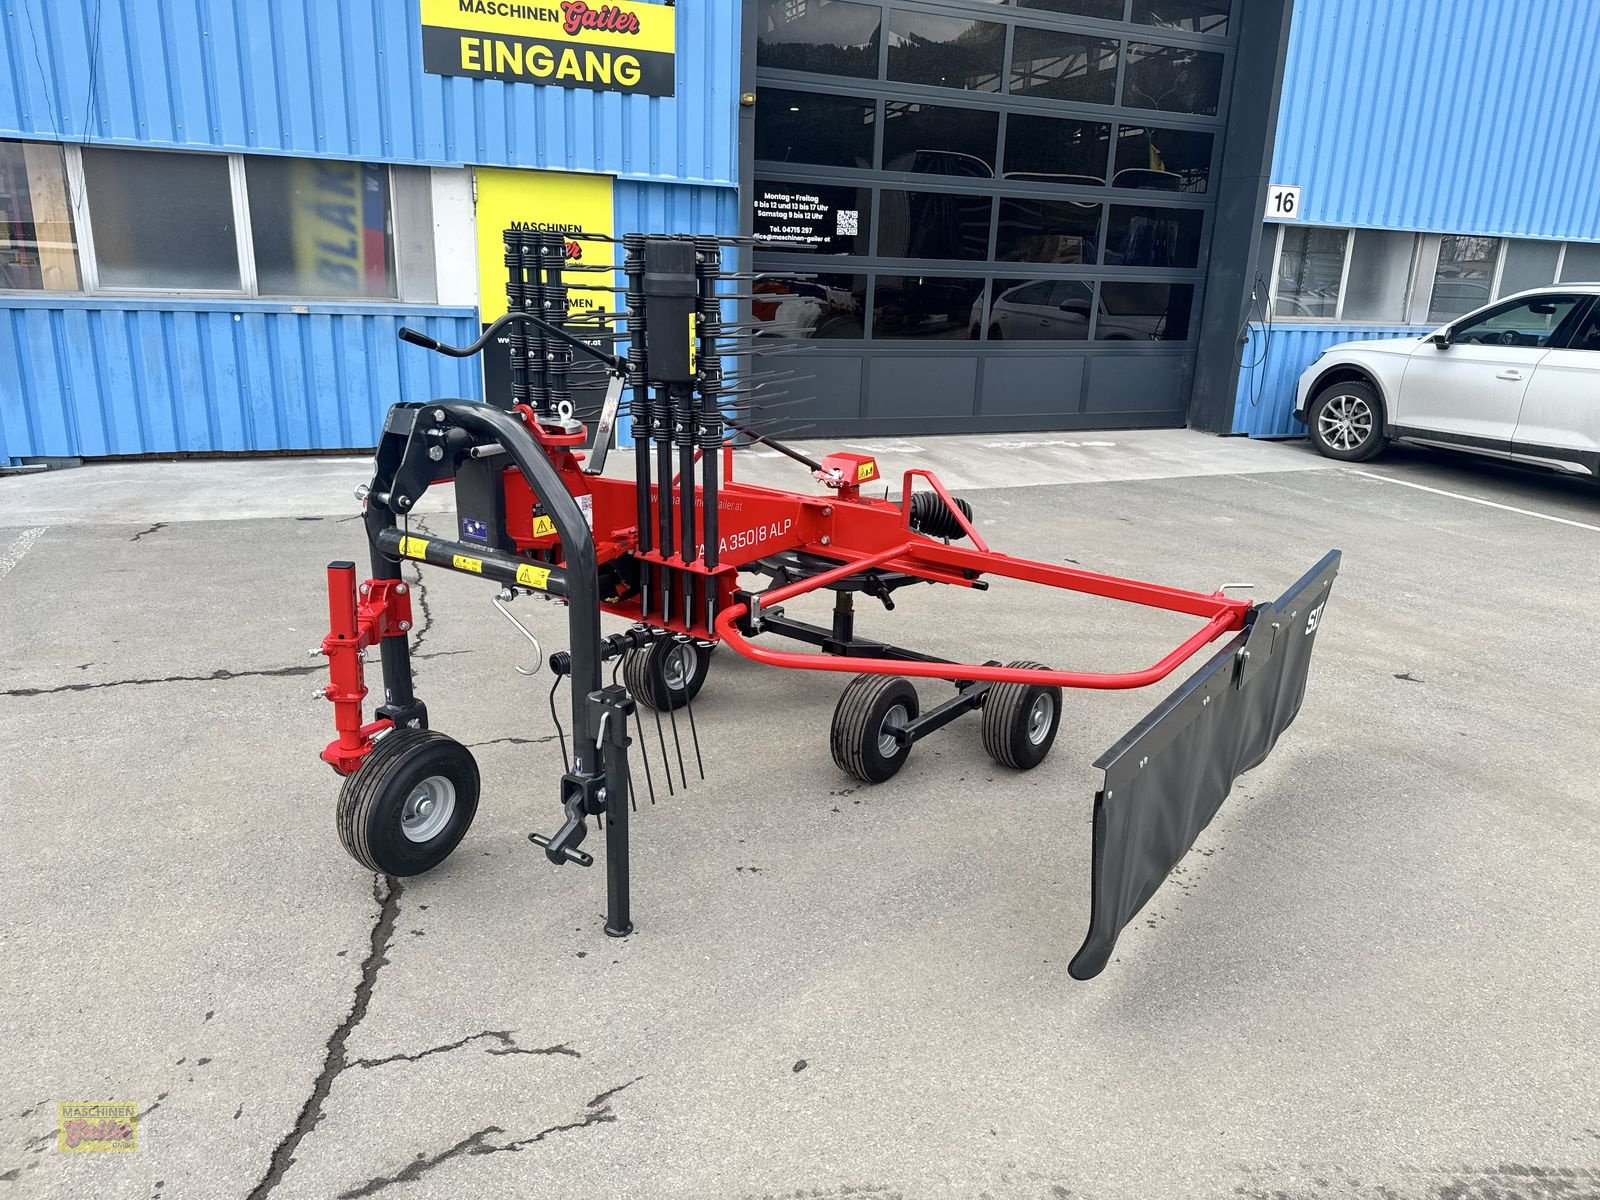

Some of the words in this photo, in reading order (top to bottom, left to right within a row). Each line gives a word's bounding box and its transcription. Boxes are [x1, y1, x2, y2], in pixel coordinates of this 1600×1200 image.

[459, 0, 559, 23] MASCHINEN
[560, 0, 640, 36] Gailer
[460, 36, 641, 86] EINGANG
[753, 200, 759, 208] 8
[764, 192, 790, 202] Montag
[795, 194, 819, 204] Freitag
[1274, 191, 1295, 213] 16
[758, 210, 788, 220] Samstag
[770, 518, 792, 538] ALP
